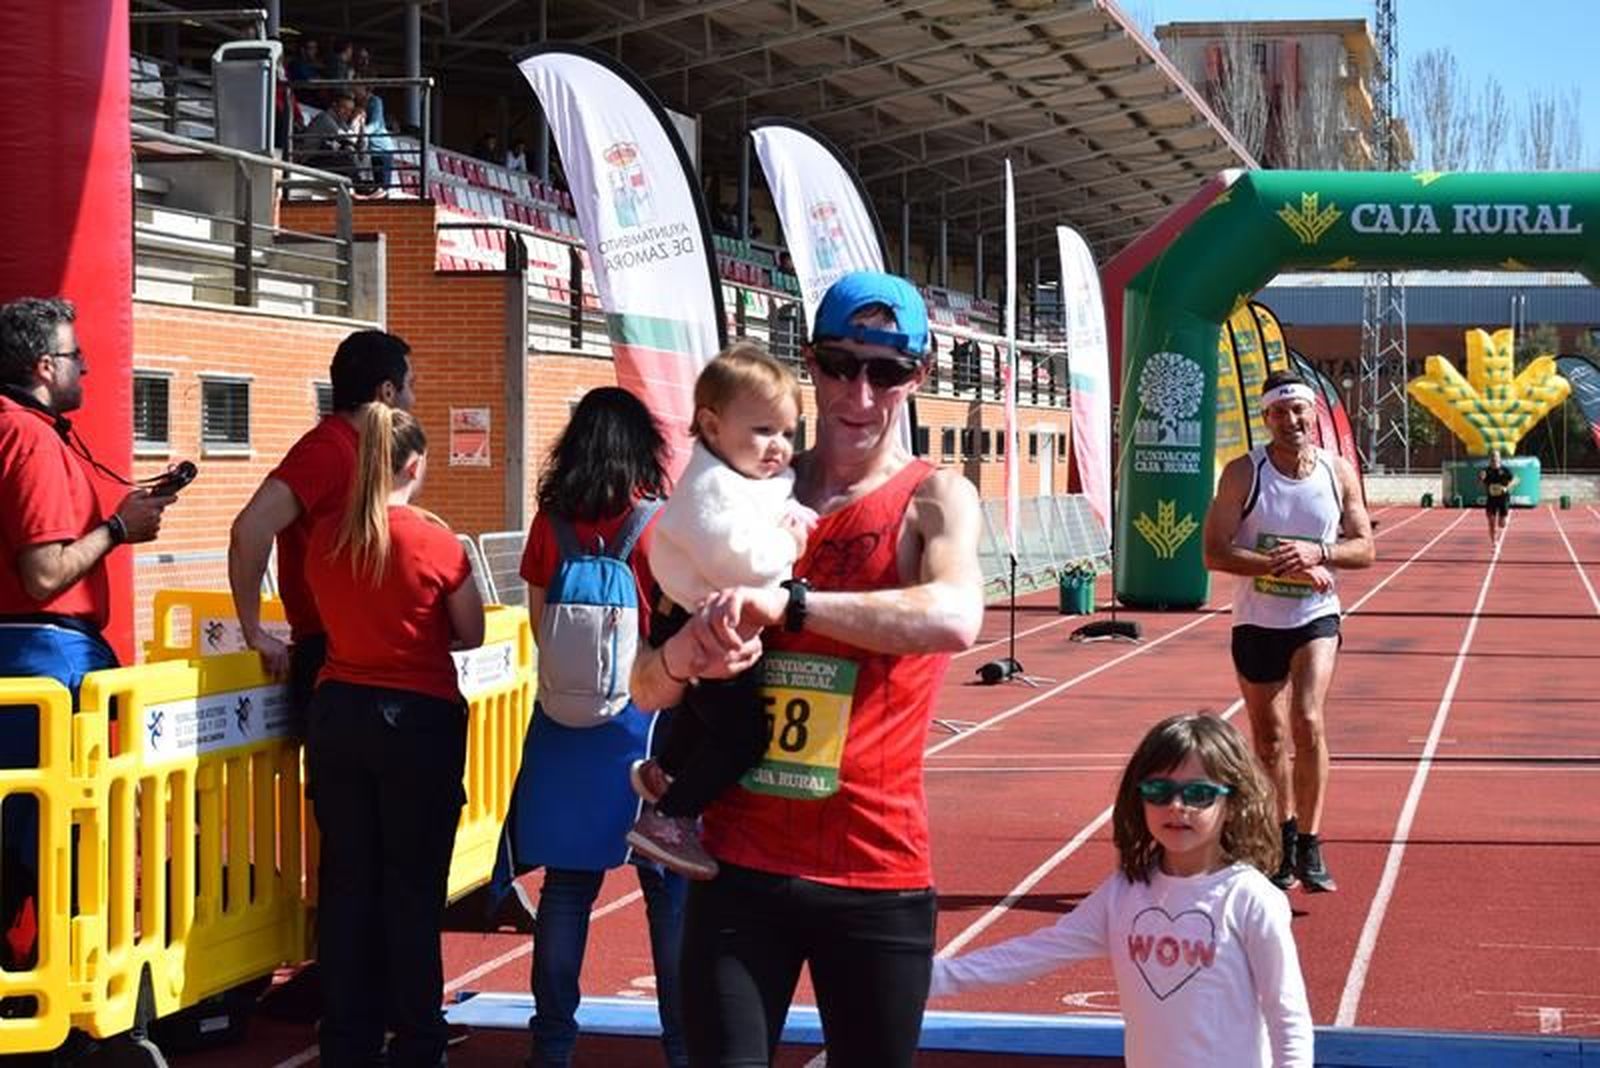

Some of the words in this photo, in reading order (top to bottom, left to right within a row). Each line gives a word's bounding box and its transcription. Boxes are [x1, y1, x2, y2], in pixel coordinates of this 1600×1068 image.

[1350, 203, 1441, 235] CAJA
[1452, 203, 1583, 234] RURAL
[778, 771, 832, 792] RURAL
[1127, 934, 1216, 968] WOW
